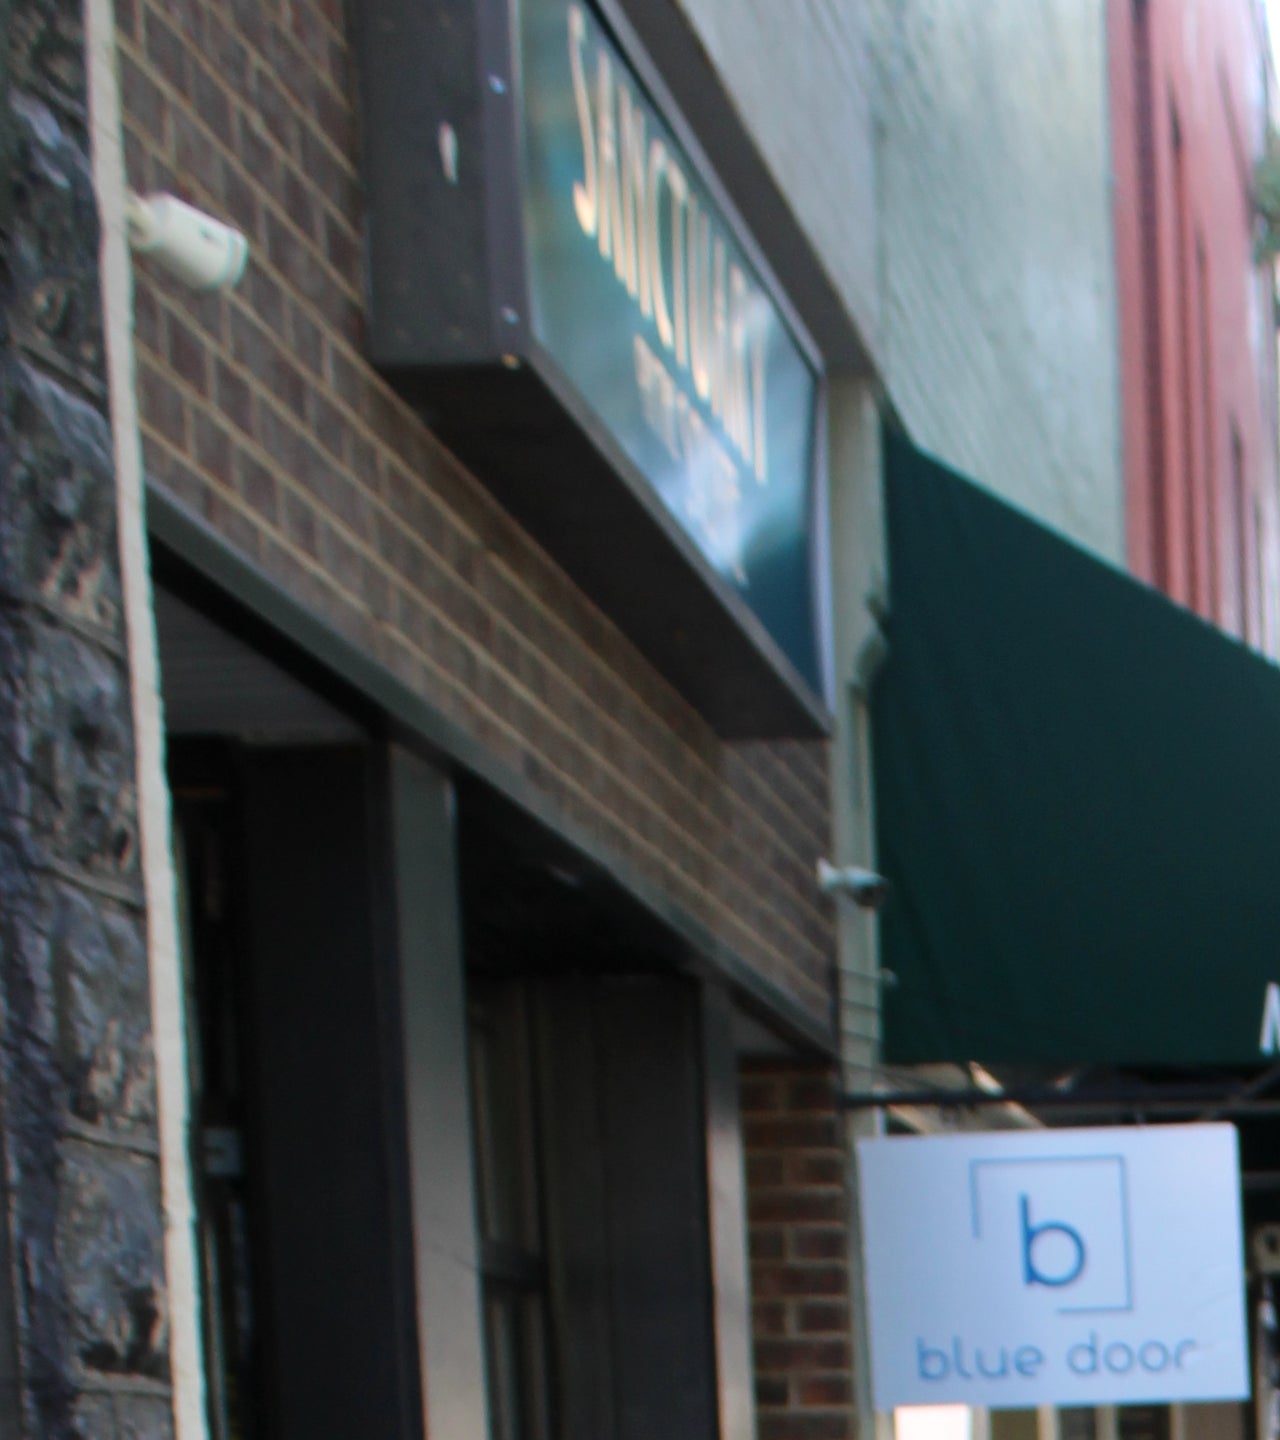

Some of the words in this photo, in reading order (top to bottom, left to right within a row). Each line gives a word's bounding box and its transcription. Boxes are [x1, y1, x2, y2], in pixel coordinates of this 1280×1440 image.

[1018, 1192, 1086, 1287] b
[916, 1335, 1045, 1381] blue
[1066, 1331, 1198, 1376] door
